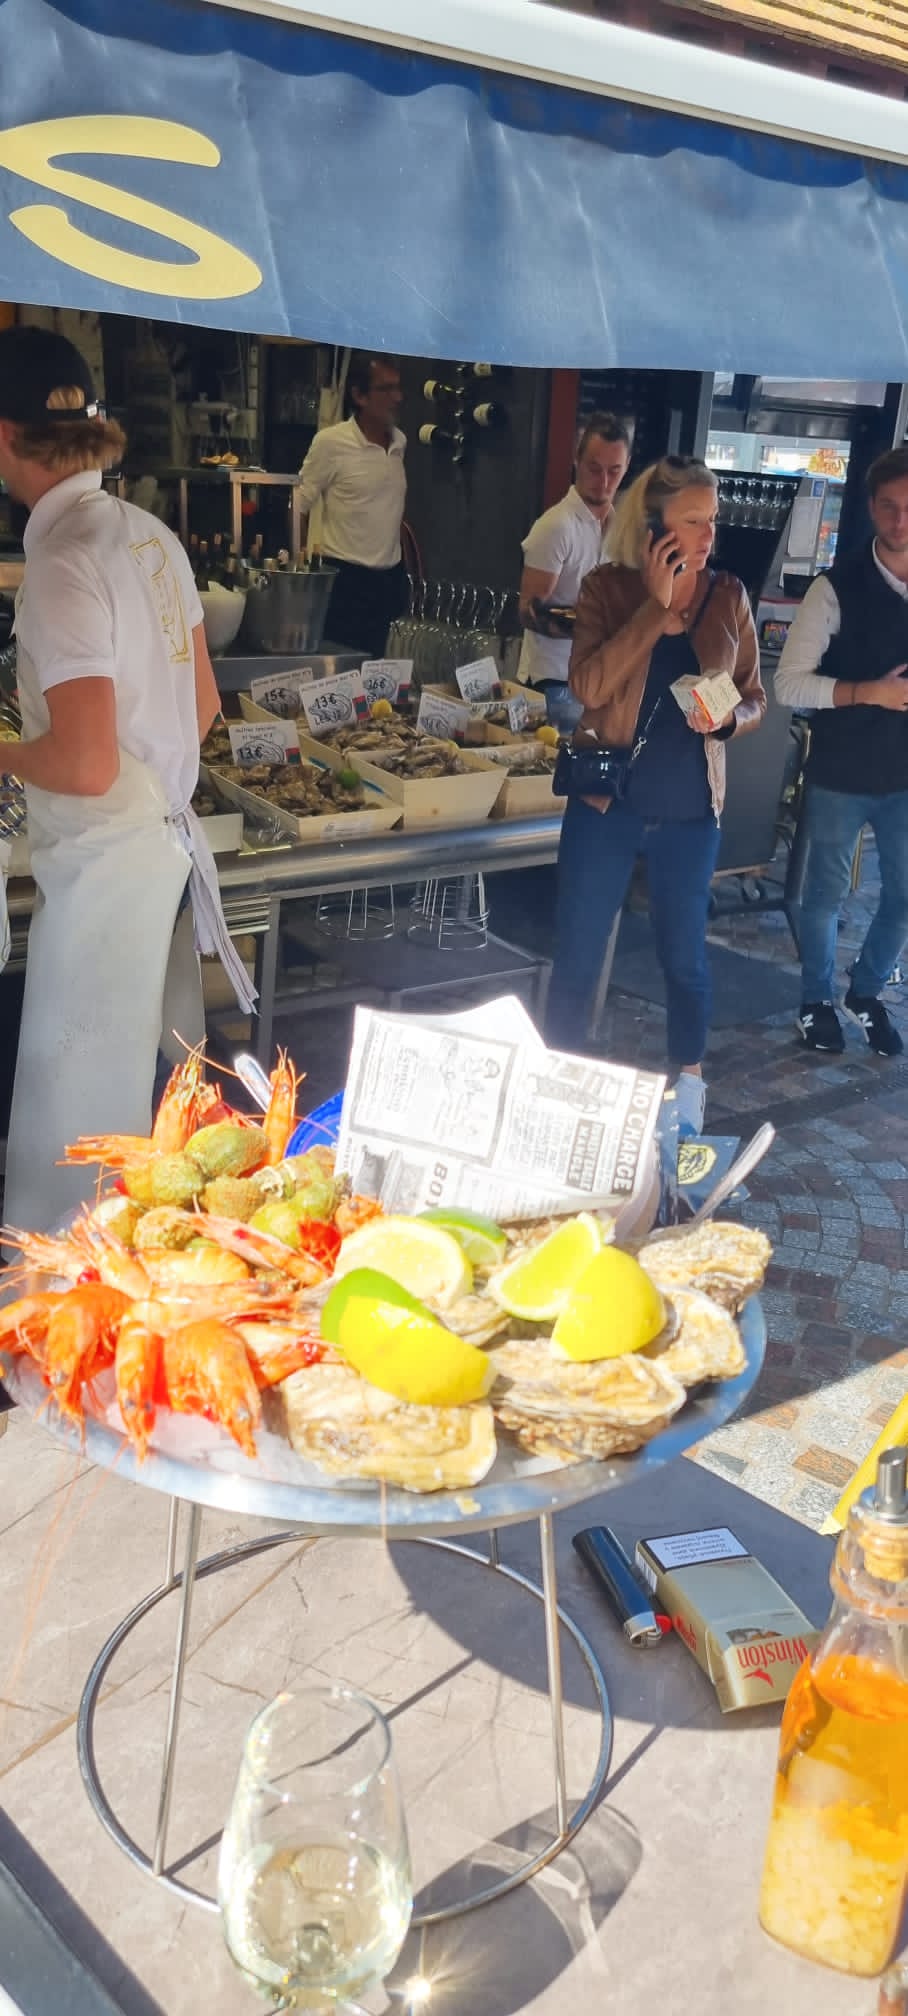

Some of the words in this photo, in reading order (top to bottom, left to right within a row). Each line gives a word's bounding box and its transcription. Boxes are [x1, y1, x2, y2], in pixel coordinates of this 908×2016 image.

[0, 114, 263, 300] S
[264, 687, 286, 704] 15€
[314, 692, 337, 710] 13€
[239, 744, 264, 760] 13€
[632, 1079, 656, 1110] NO
[613, 1112, 647, 1192] CHARGE
[736, 1637, 808, 1669] Winston
